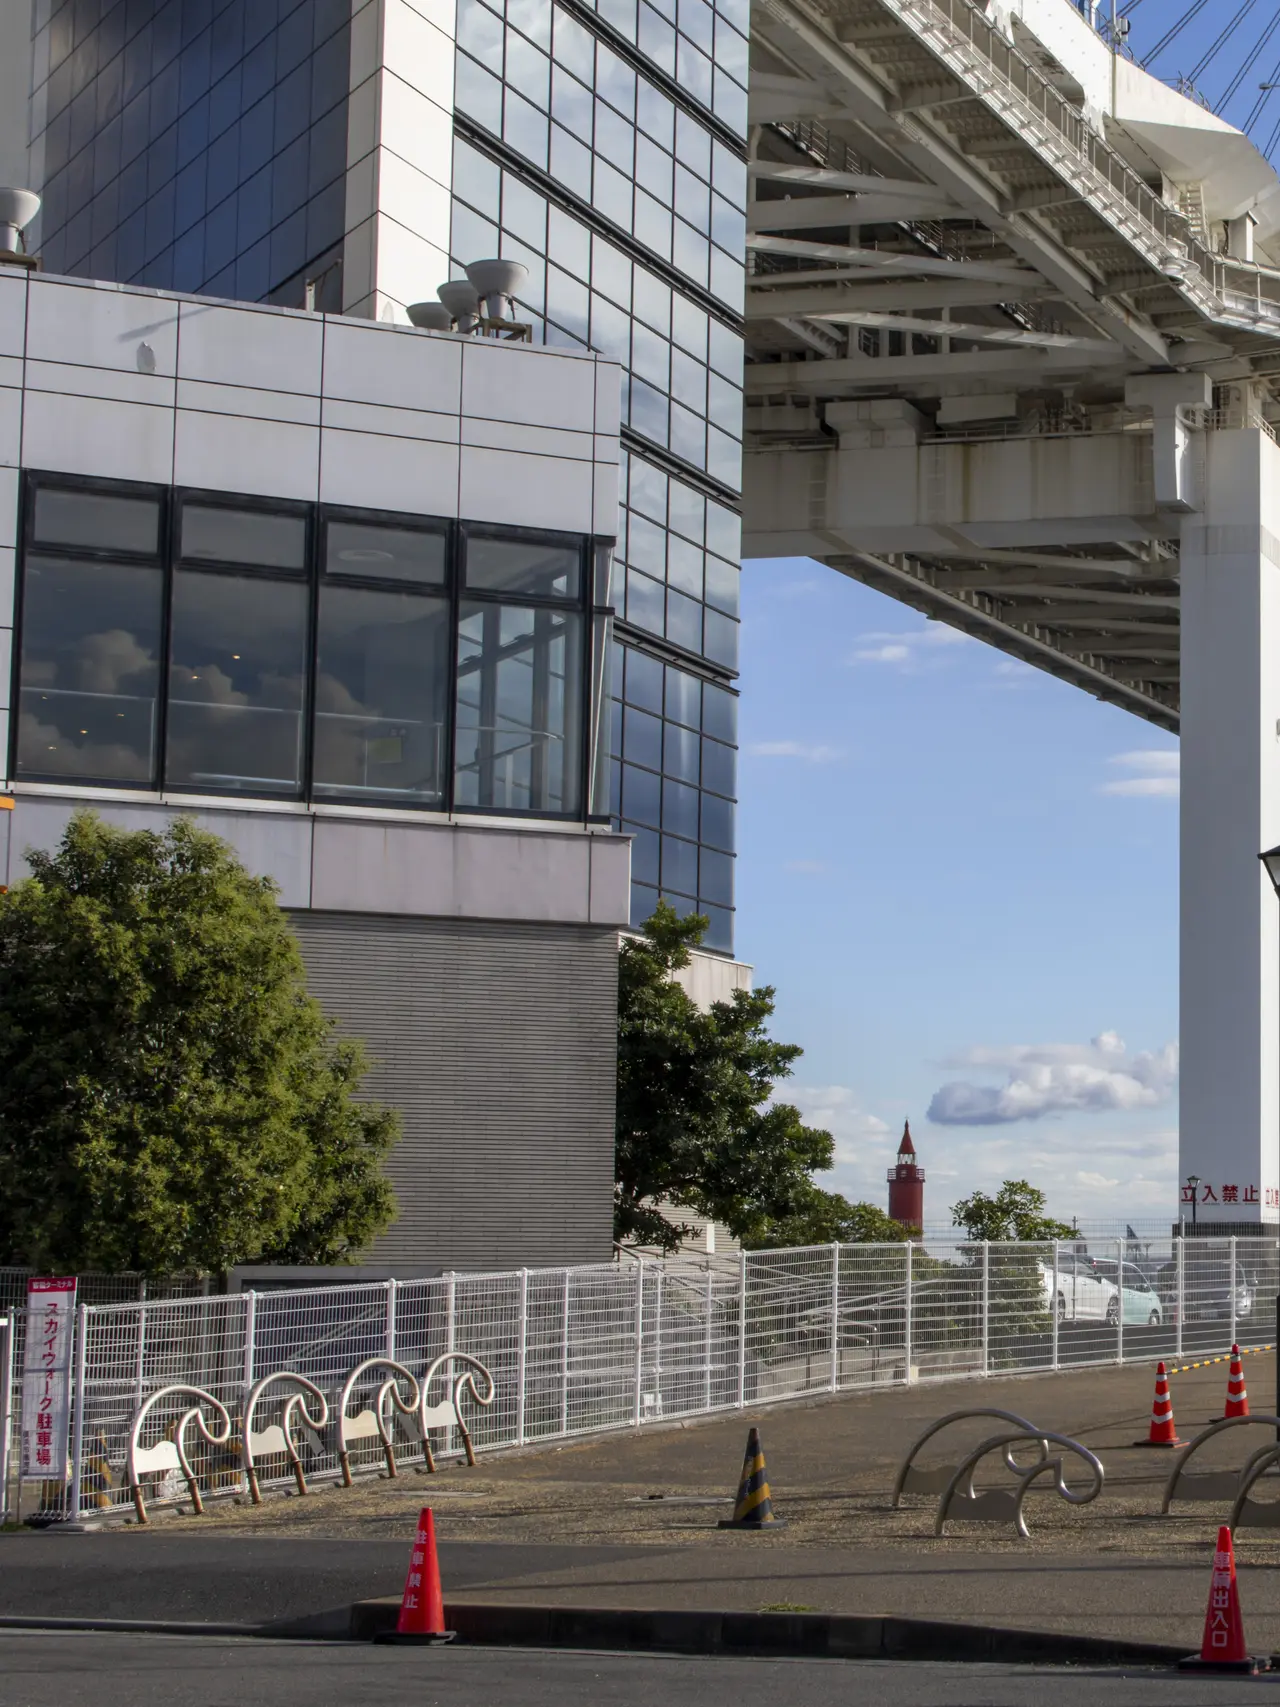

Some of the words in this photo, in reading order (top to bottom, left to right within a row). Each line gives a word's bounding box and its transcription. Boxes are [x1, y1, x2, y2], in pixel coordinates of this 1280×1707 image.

[1181, 1184, 1260, 1203] 立入禁止
[35, 1303, 58, 1466] スカイウォーク駐車場
